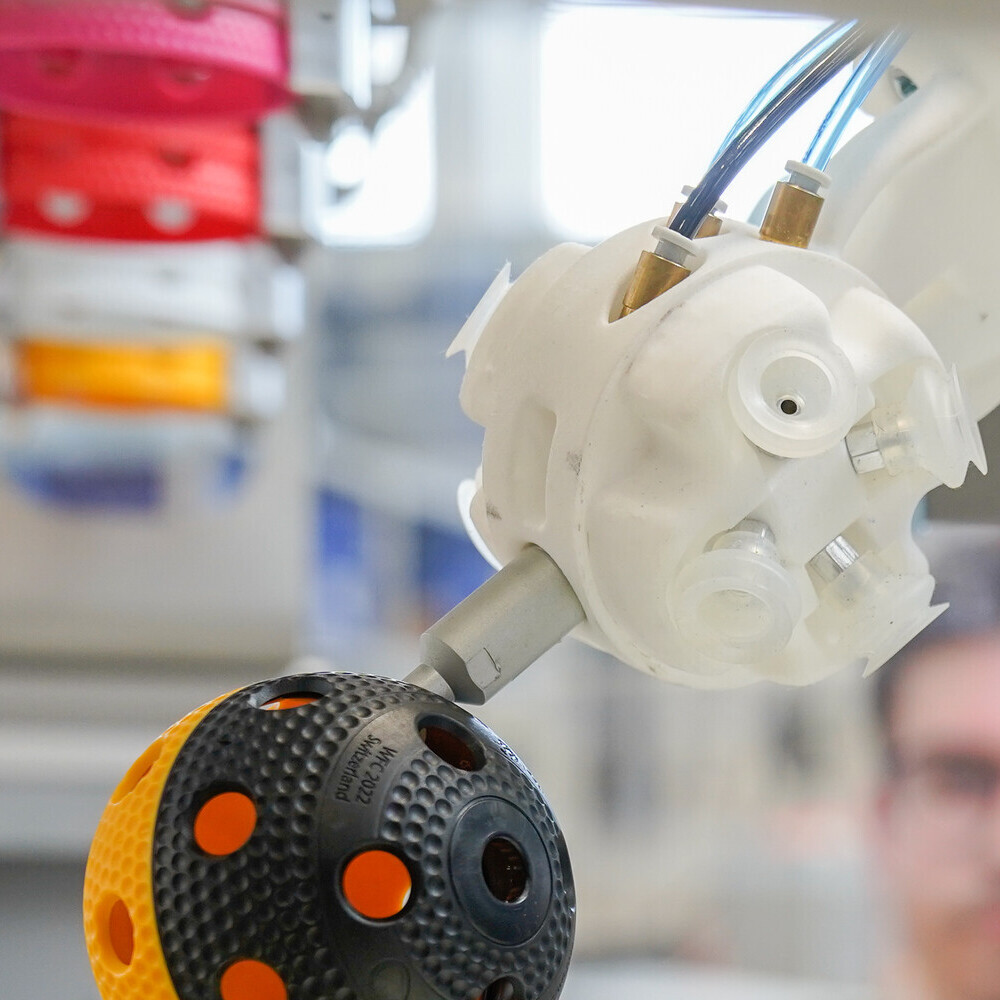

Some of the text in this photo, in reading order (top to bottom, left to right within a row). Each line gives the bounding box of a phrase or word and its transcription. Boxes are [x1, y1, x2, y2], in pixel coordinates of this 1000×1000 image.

[335, 734, 382, 802] Switzerland
[355, 746, 398, 805] WFC 2022
